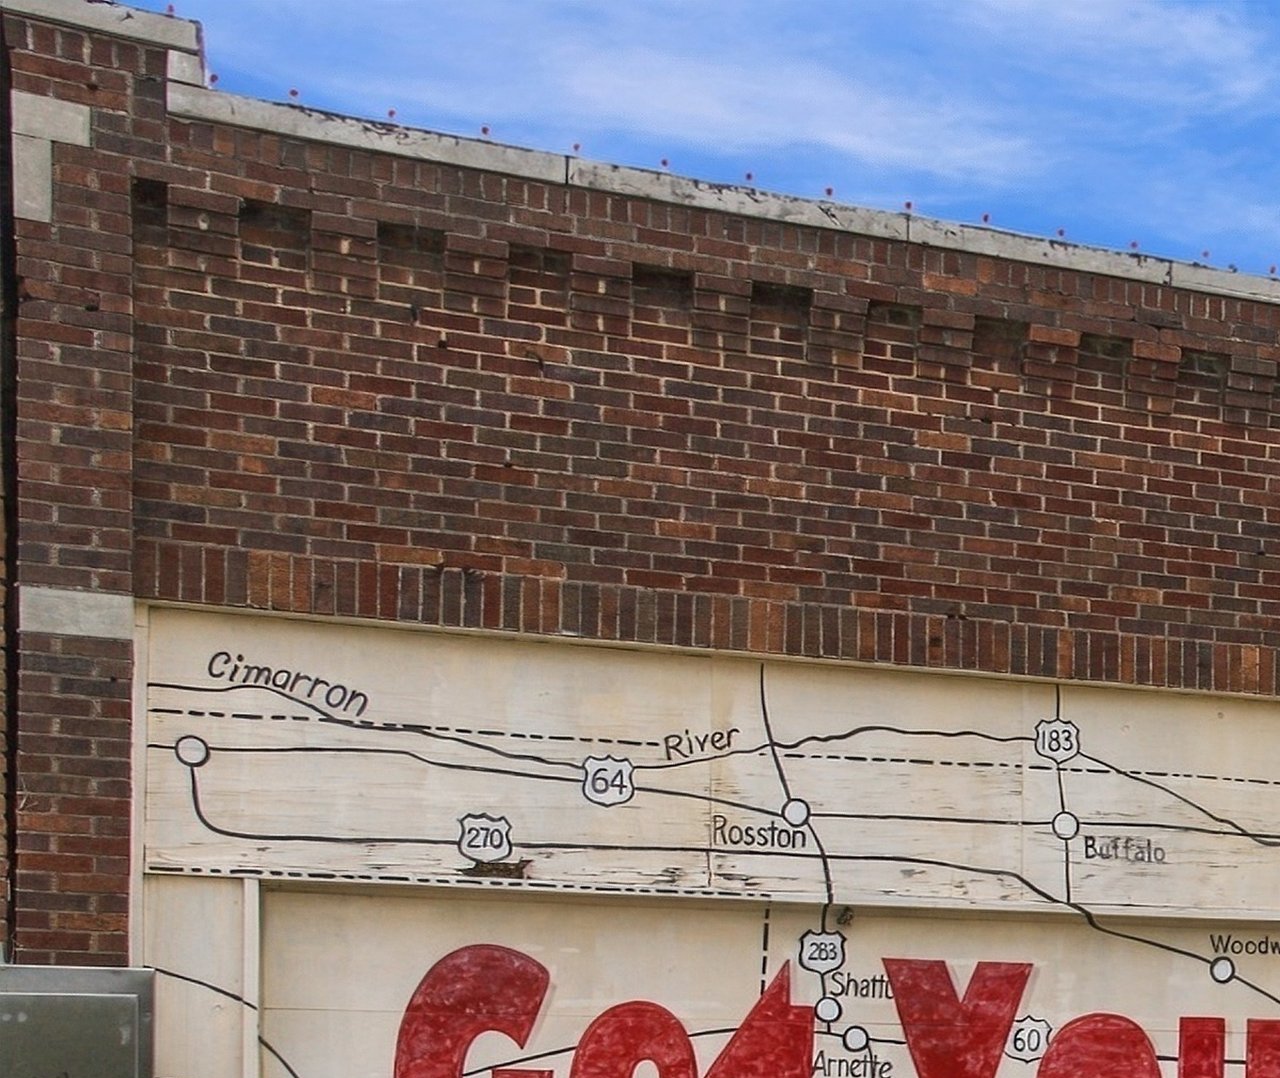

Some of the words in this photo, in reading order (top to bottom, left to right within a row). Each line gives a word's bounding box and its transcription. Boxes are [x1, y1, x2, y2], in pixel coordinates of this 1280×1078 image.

[207, 650, 370, 718] Cimarron
[664, 725, 741, 762] River
[1037, 728, 1074, 752] 183
[589, 768, 628, 796] 64
[465, 826, 504, 850] 270
[711, 822, 807, 850] Rosston
[1083, 836, 1167, 864] Buffalo
[807, 941, 838, 962] 283
[1013, 1026, 1042, 1054] 60
